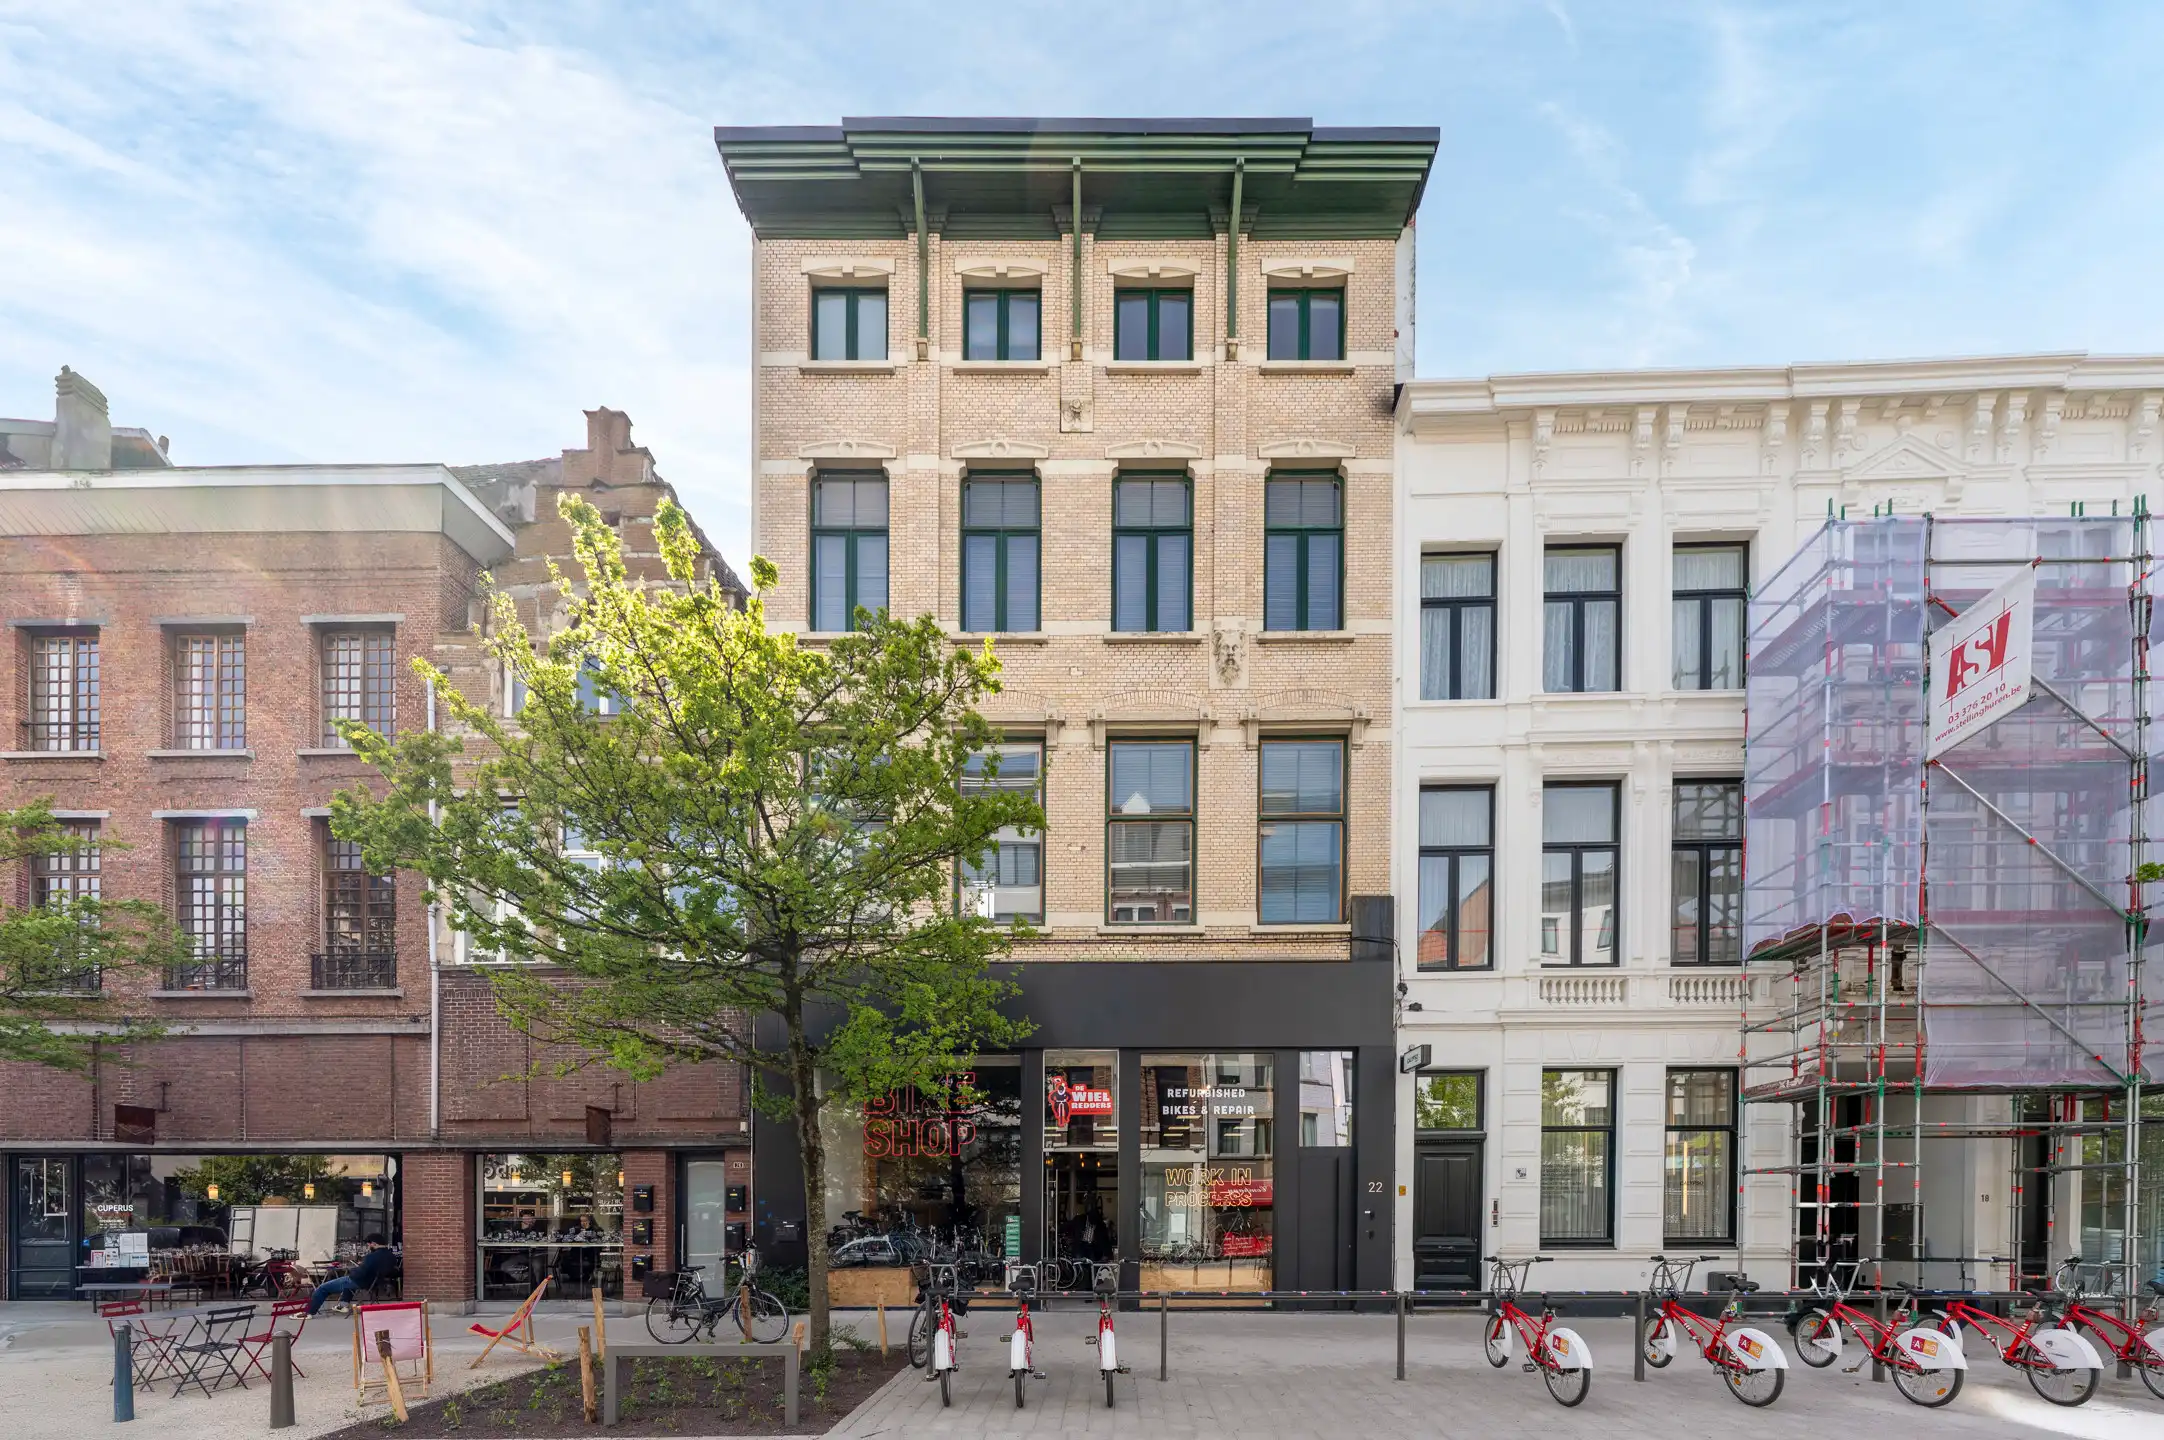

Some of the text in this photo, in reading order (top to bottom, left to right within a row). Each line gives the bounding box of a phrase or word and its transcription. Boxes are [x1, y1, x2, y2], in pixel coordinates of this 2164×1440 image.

[1945, 610, 2012, 699] ASV
[1947, 682, 2007, 724] 03 376 20 10
[1935, 685, 2022, 742] www.stellinghuren.be
[1071, 1091, 1111, 1102] WIEL
[1166, 1088, 1246, 1098] REFURBISHED
[1162, 1105, 1255, 1115] BIKES & REPAIR
[863, 1118, 977, 1158] SHOP
[1165, 1168, 1252, 1186] WORK IN
[1368, 1181, 1383, 1193] 22
[1980, 1194, 1990, 1203] 18
